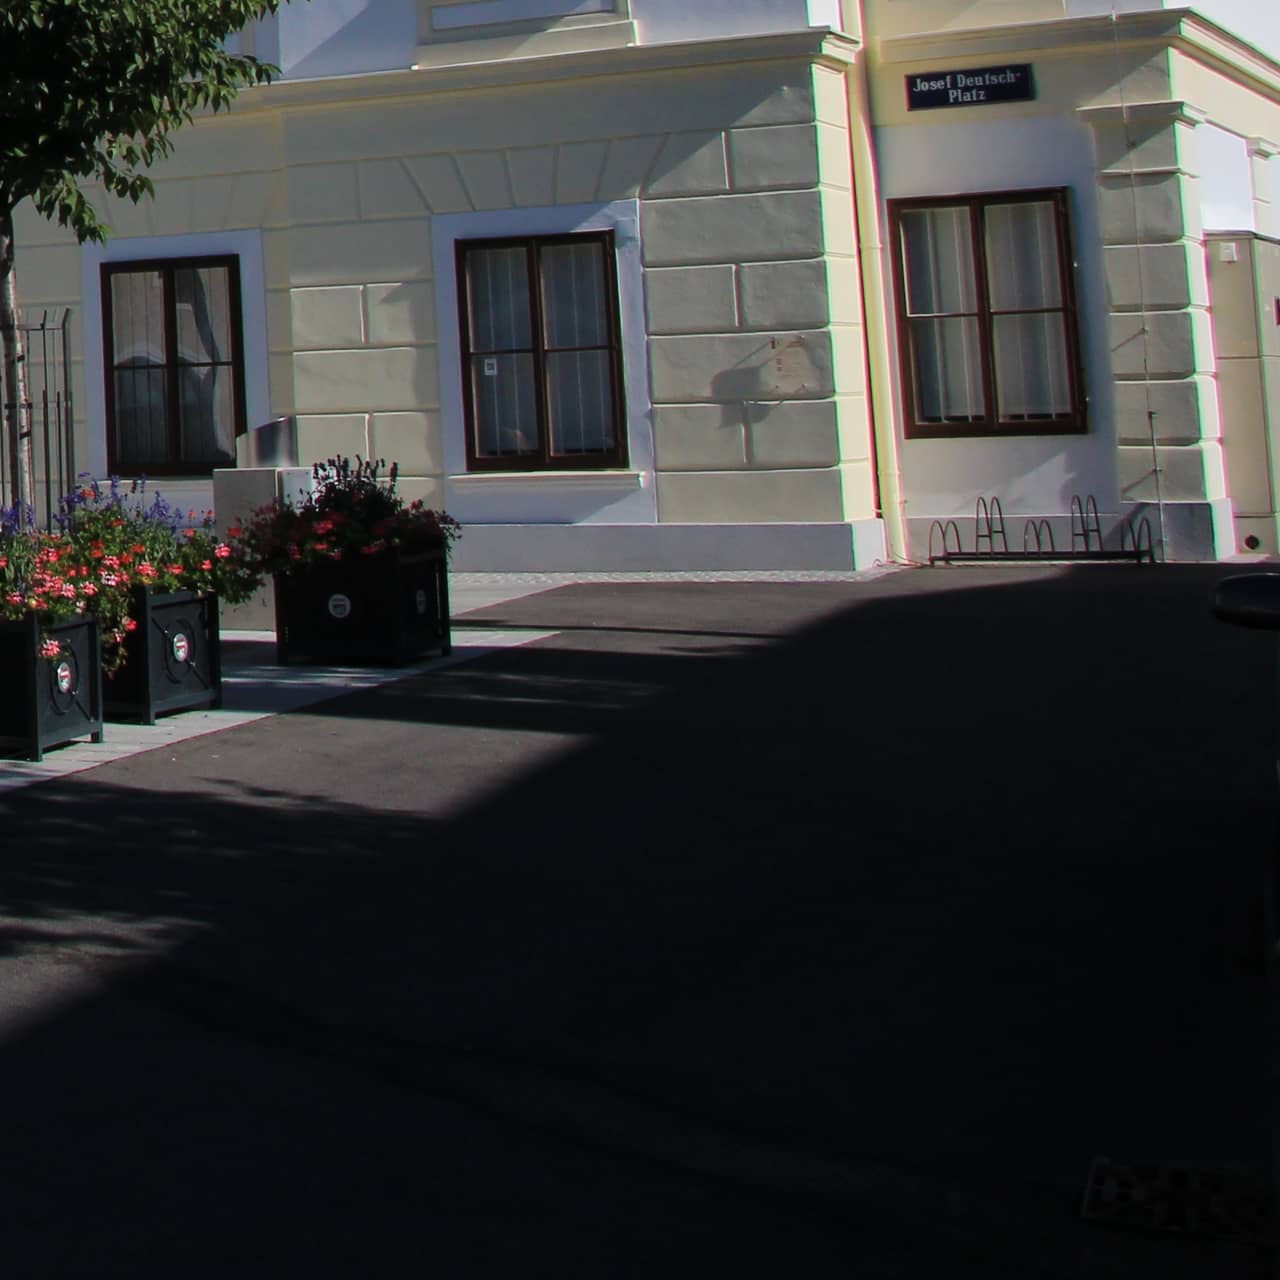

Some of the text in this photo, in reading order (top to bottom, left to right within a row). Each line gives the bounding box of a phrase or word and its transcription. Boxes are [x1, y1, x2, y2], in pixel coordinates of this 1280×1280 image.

[912, 69, 1022, 92] Josef Deutsch-
[948, 88, 986, 103] Platz
